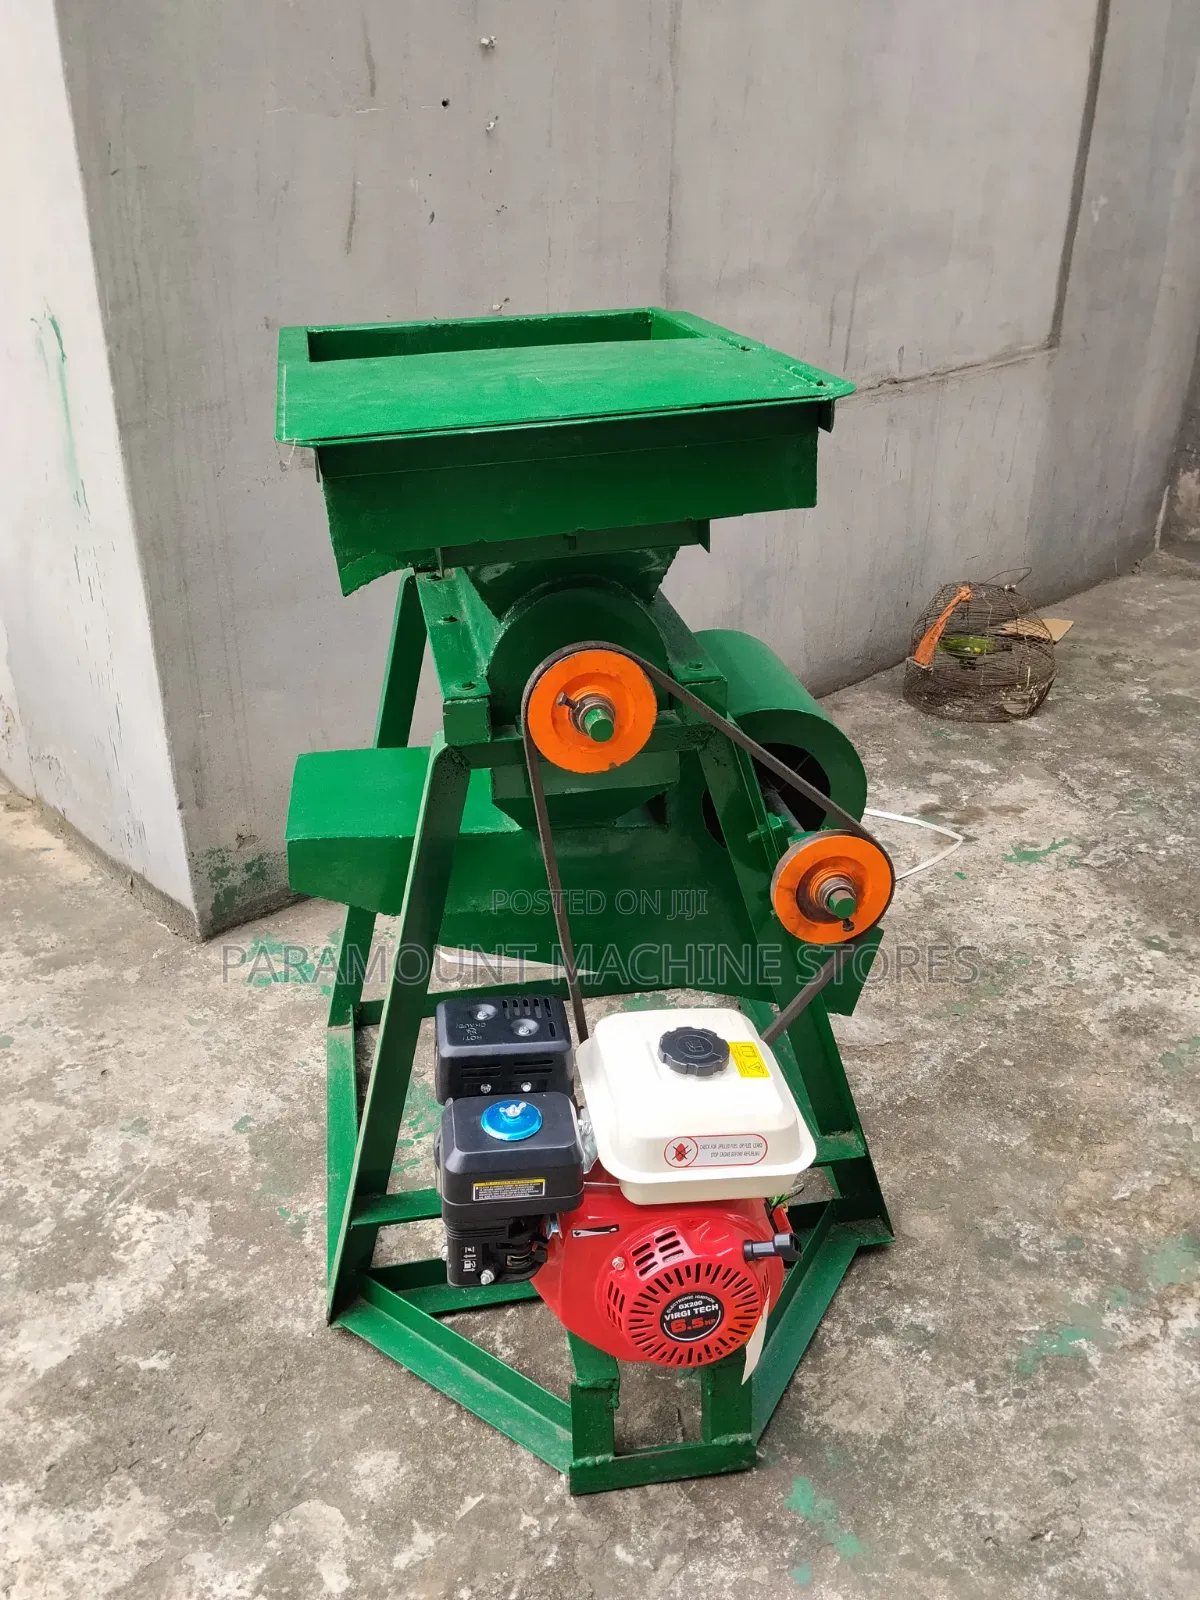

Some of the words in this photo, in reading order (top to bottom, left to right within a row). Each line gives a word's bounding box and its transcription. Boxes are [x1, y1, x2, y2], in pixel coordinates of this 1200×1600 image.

[678, 1300, 703, 1310] GX200
[664, 1309, 691, 1321] VIRGI
[693, 1304, 718, 1314] TECH
